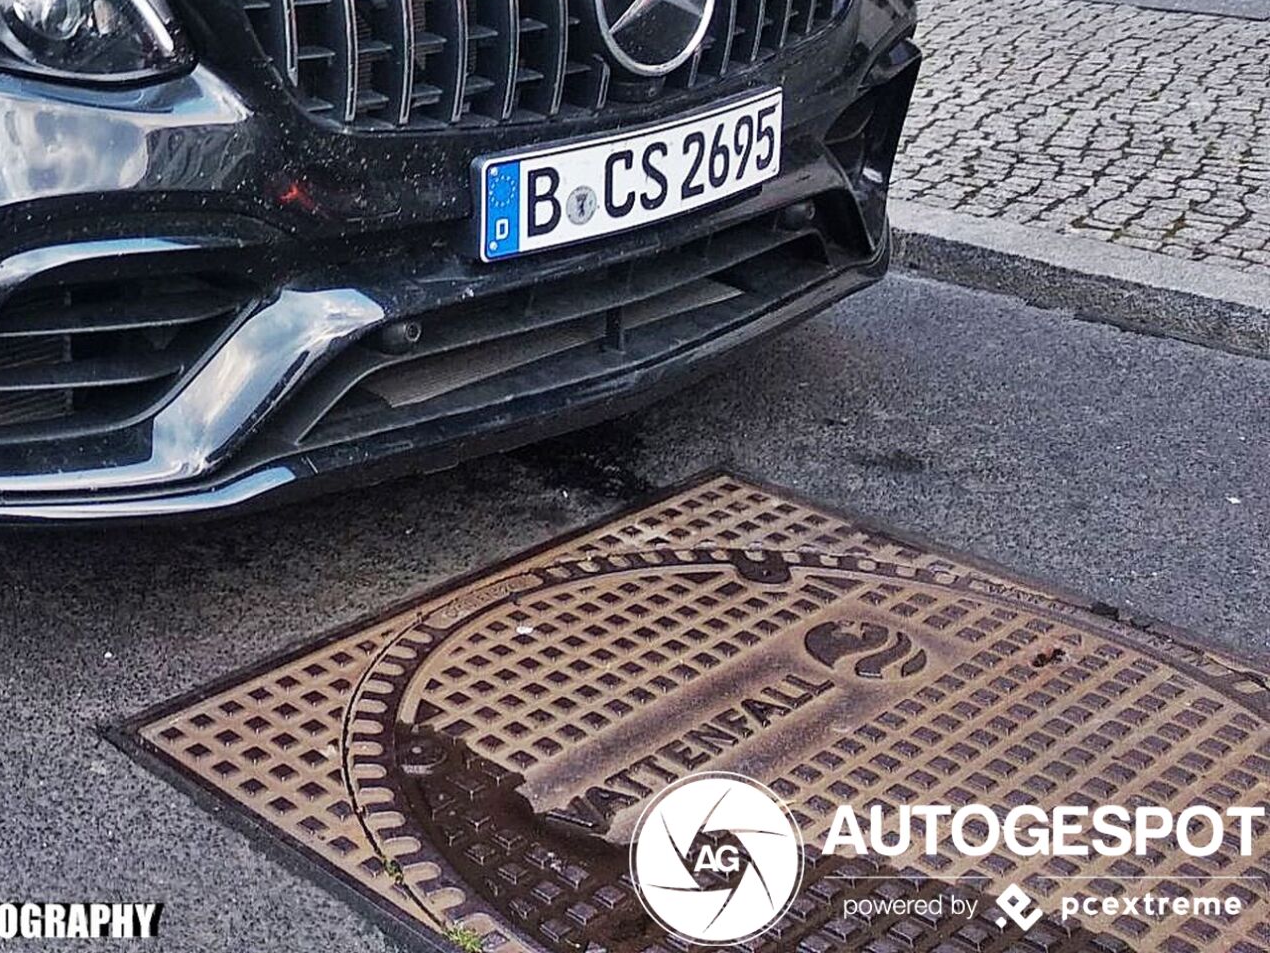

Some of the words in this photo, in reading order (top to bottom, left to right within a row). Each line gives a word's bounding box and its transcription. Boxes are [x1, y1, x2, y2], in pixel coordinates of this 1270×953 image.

[495, 218, 509, 240] D
[527, 166, 561, 238] B
[604, 141, 668, 219] CS
[681, 104, 780, 200] 2695
[547, 673, 835, 834] VATTENFALL
